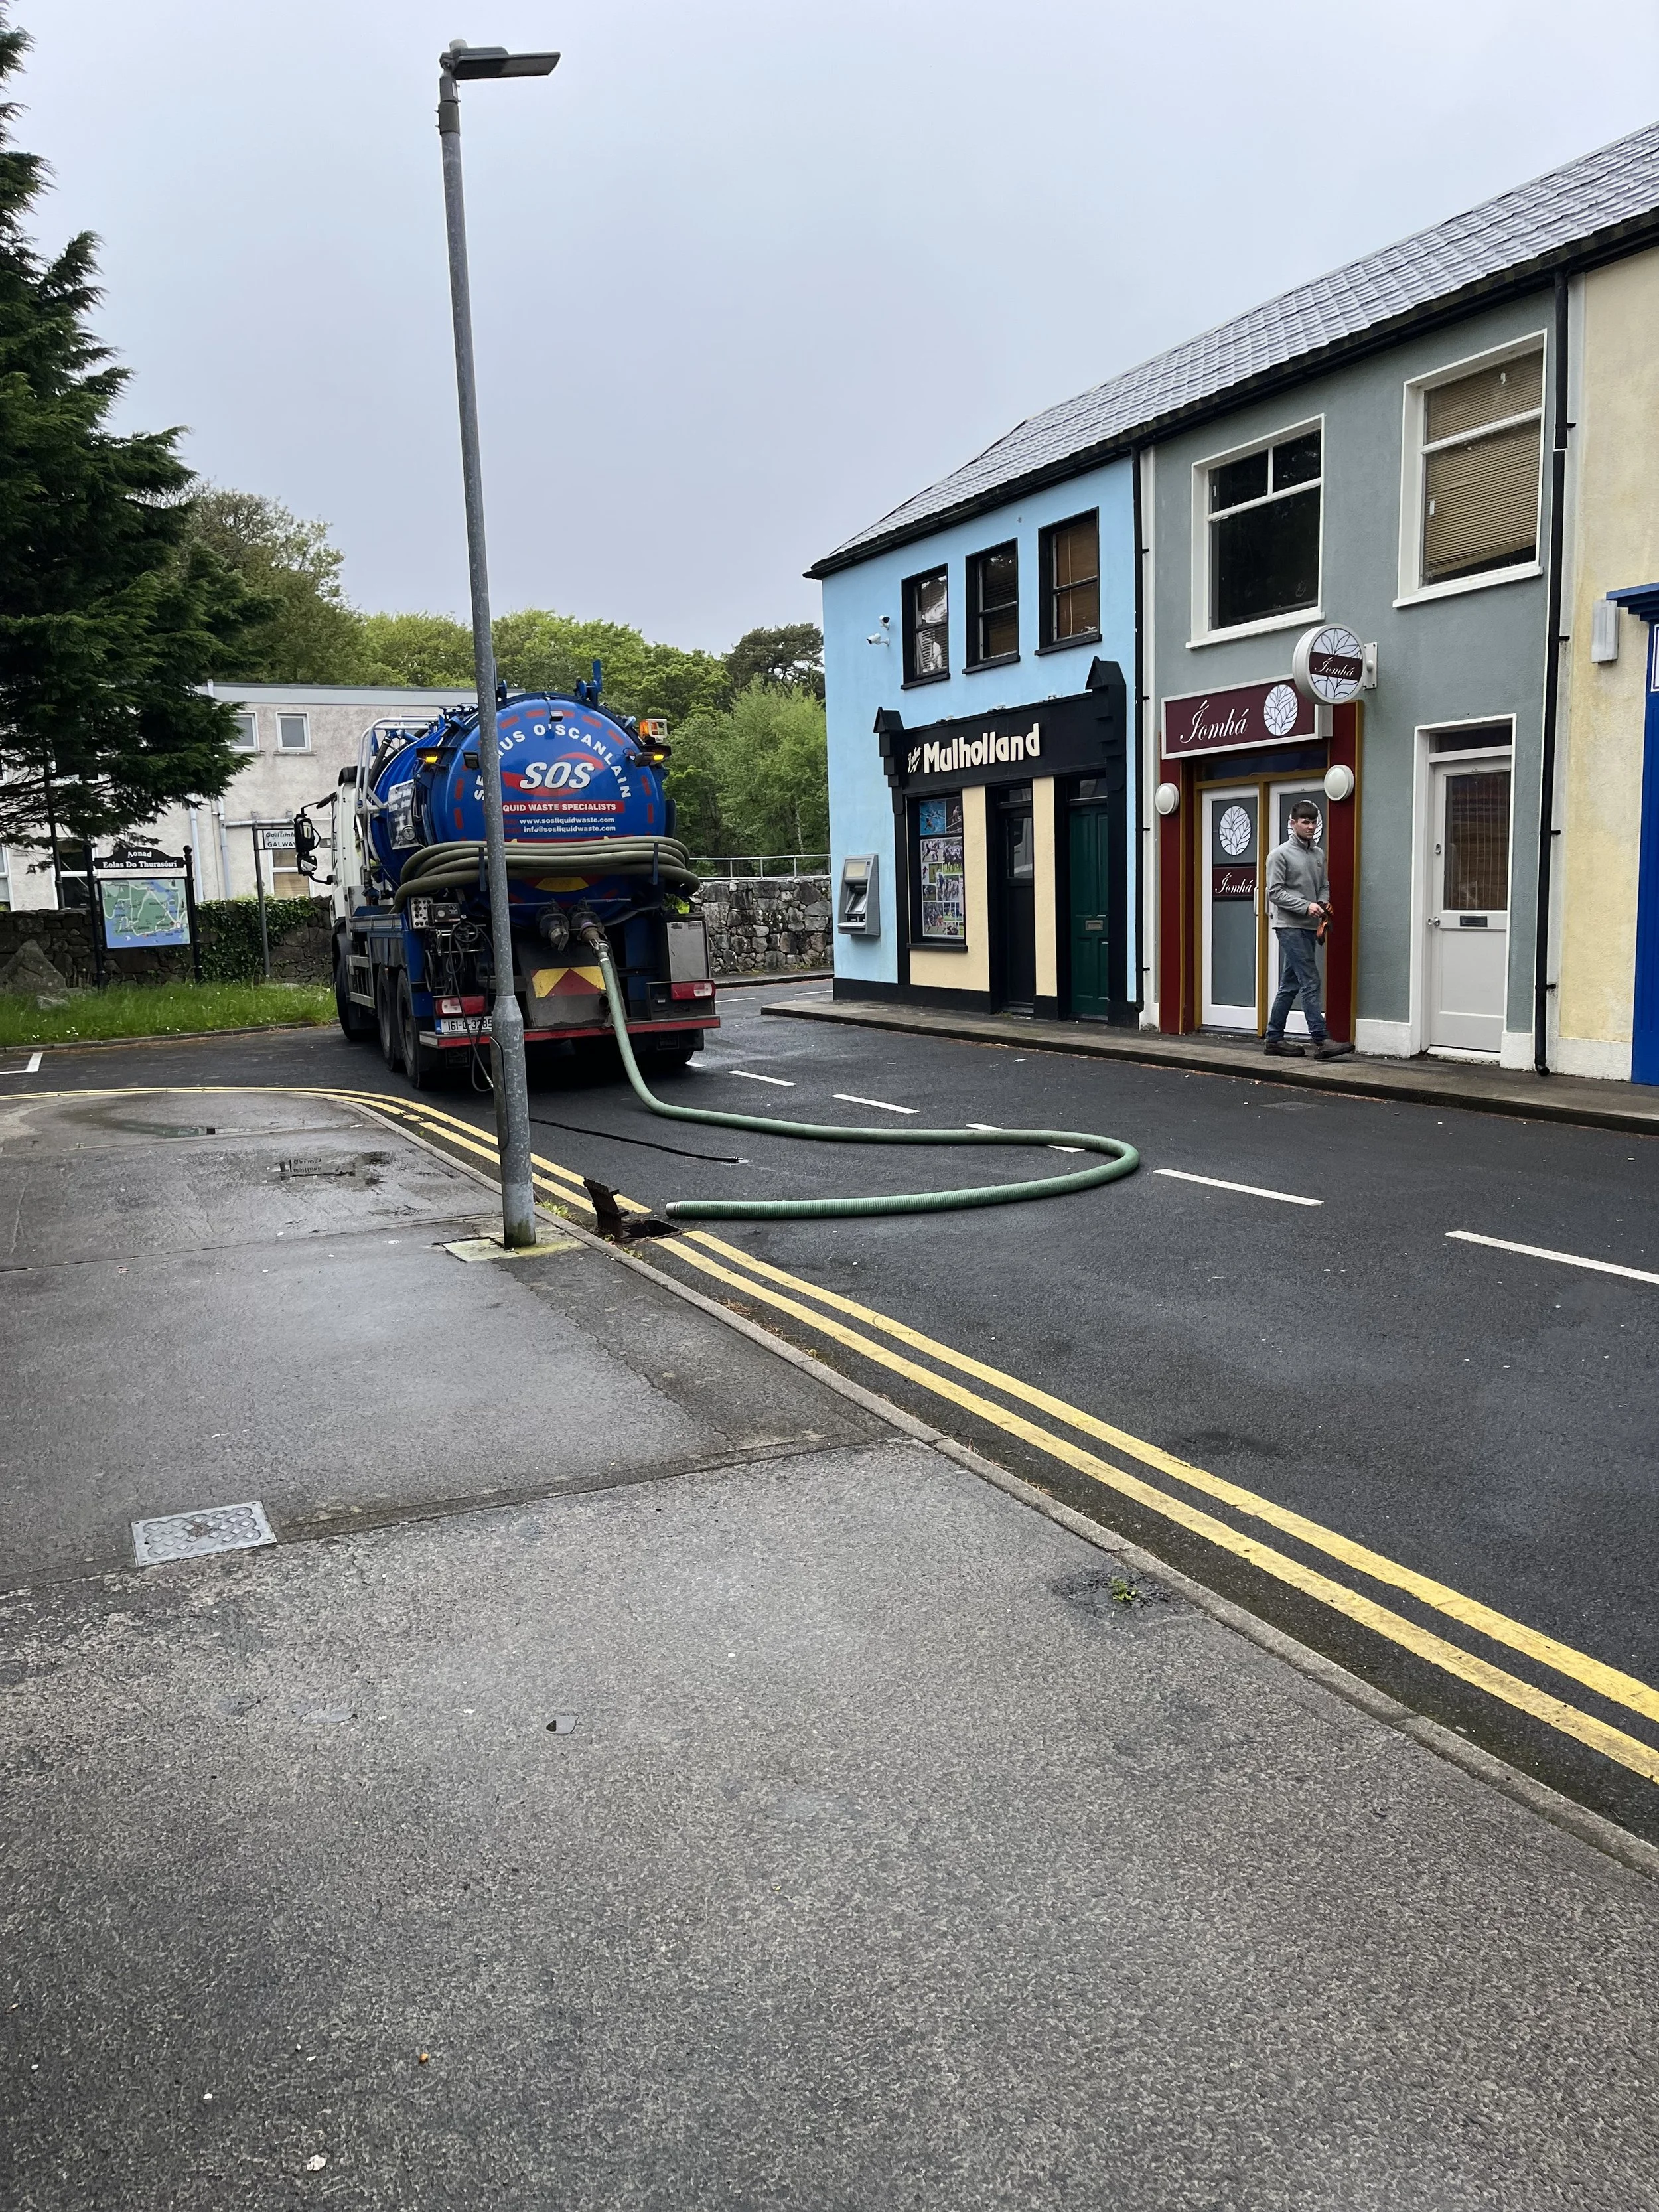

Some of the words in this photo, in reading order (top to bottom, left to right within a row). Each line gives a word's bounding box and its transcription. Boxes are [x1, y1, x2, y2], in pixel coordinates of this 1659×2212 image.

[1314, 657, 1355, 677] Íomhá
[1179, 700, 1250, 744] Íomhá
[533, 723, 632, 798] O'SCANLAIN
[924, 723, 1041, 774] Mulholland
[519, 761, 595, 790] SOS
[1215, 871, 1254, 893] Íomhá
